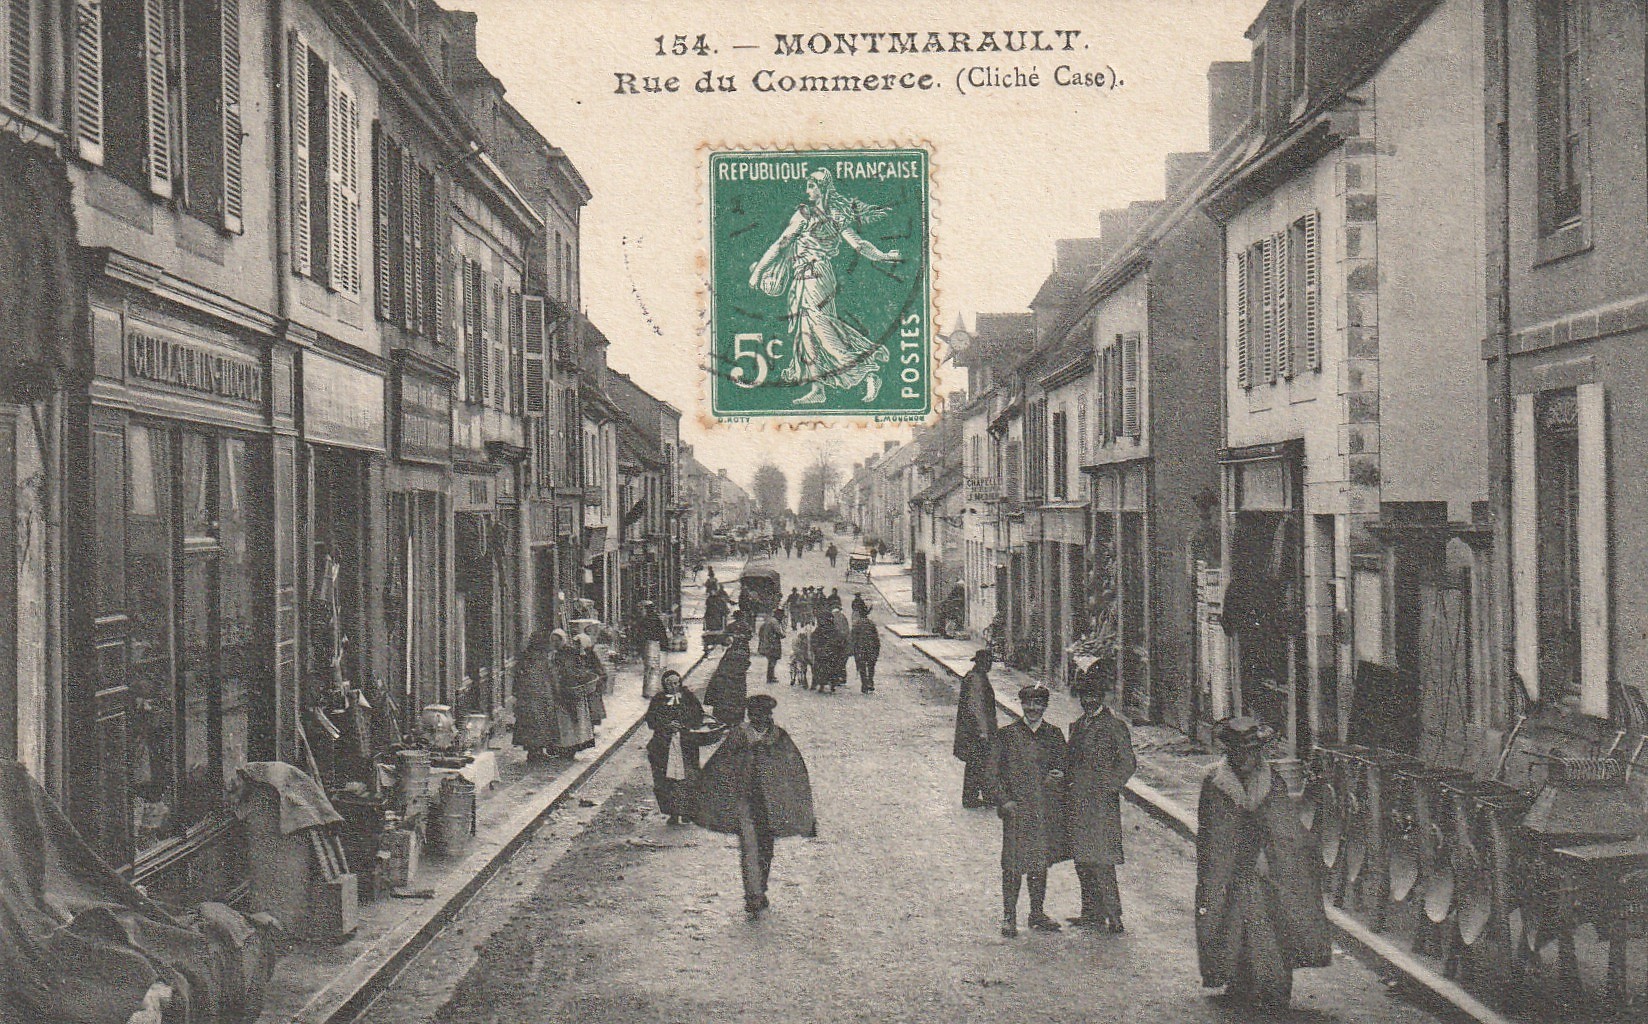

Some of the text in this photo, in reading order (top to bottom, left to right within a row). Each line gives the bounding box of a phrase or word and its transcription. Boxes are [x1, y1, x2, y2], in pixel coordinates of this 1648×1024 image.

[718, 160, 920, 183] REPUBLIQUE FRANÇAISE
[900, 313, 921, 399] POSTES
